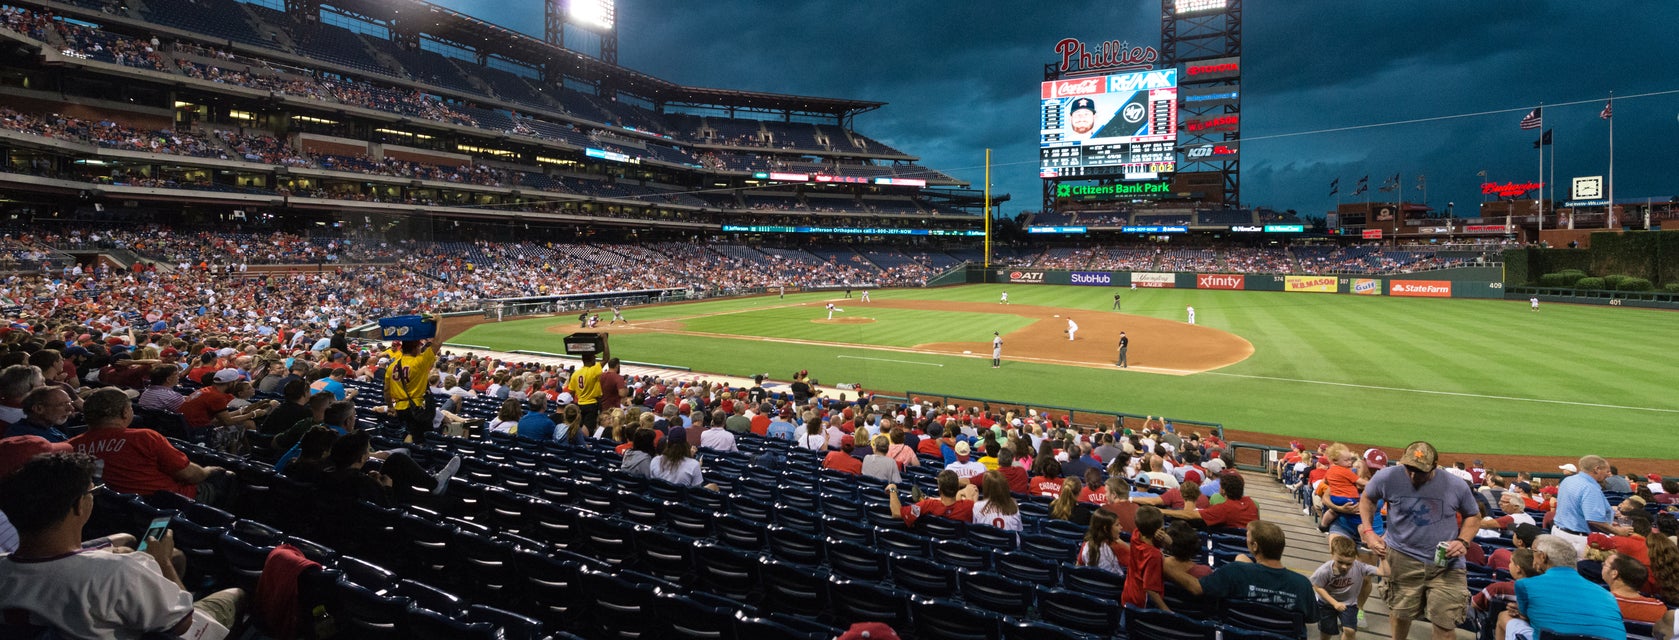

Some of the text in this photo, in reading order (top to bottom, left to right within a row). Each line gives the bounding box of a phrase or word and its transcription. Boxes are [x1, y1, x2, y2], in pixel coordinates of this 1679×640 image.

[1055, 38, 1158, 72] Phillies
[1200, 63, 1239, 73] TOYOTA
[1072, 183, 1114, 195] Citizens
[1115, 182, 1142, 193] Bank
[1144, 181, 1170, 192] Park
[1021, 272, 1044, 280] ATI
[1071, 273, 1111, 284] StubHub
[1200, 275, 1241, 289] xfinity
[1355, 282, 1376, 291] Gulf
[578, 375, 585, 390] 9
